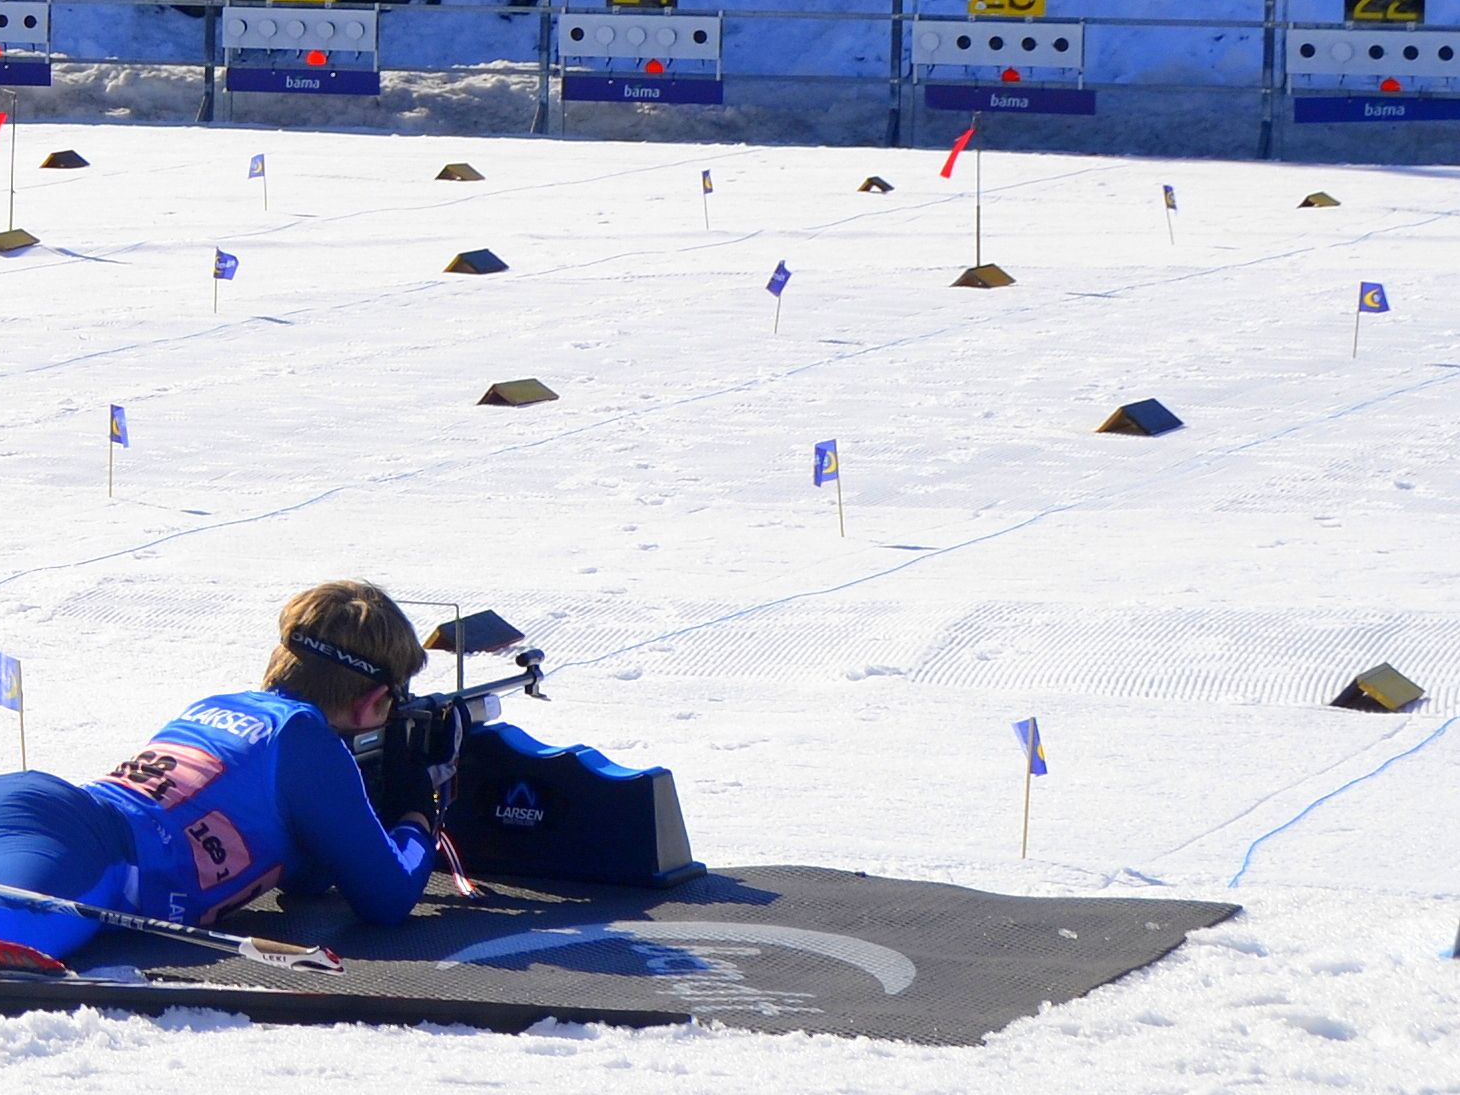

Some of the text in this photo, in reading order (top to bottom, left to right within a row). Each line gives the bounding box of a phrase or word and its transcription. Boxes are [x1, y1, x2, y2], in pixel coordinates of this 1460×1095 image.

[291, 632, 381, 674] ONE WAY
[181, 703, 274, 746] LARSEN
[495, 805, 544, 821] LARSEN
[262, 953, 287, 963] LEKI
